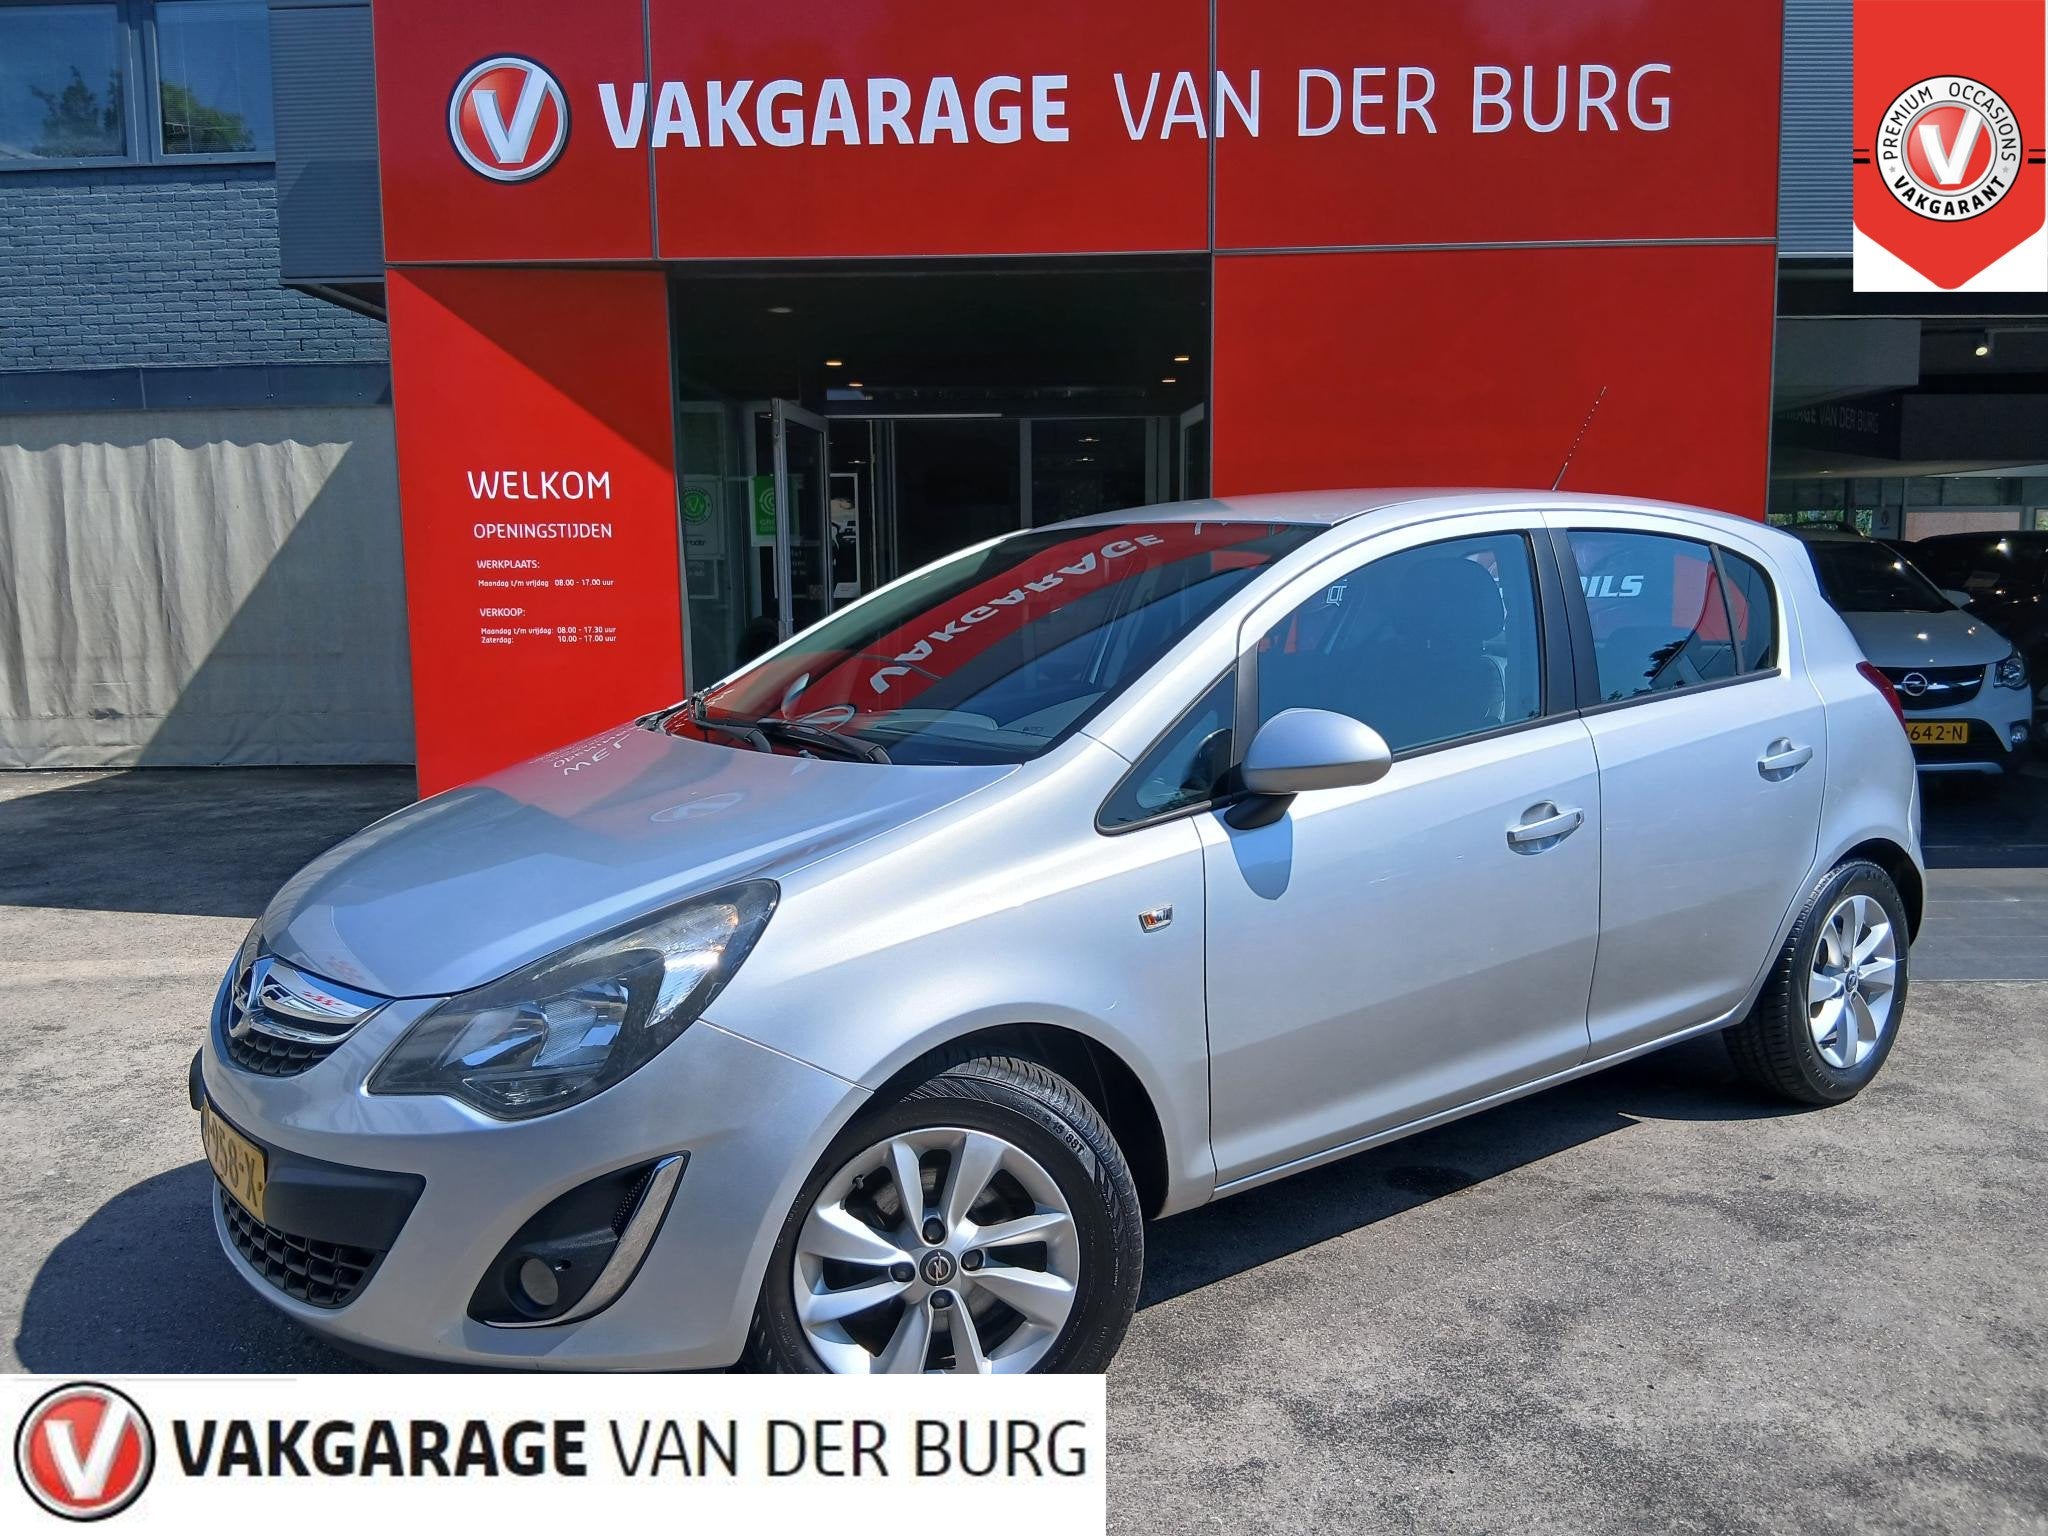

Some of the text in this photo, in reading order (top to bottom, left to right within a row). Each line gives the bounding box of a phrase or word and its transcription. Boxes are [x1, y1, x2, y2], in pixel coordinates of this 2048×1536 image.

[598, 63, 1671, 148] VAKGARAGE VAN DER BURG
[467, 471, 611, 499] WELKOM
[473, 523, 613, 538] OPENINGSTIJDEN
[476, 560, 540, 569] WERKPLAATS:
[478, 579, 509, 588] Maandag
[511, 579, 524, 587] t/m
[582, 579, 600, 587] 17.00
[480, 608, 526, 617] VERKOOP:
[481, 627, 511, 636] Maandag
[514, 627, 526, 635] t/m
[557, 626, 576, 634] 08.00
[584, 626, 602, 634] 17.30
[481, 635, 514, 645] Zaterdag:
[558, 634, 577, 643] 10.00
[584, 634, 603, 643] 17.00
